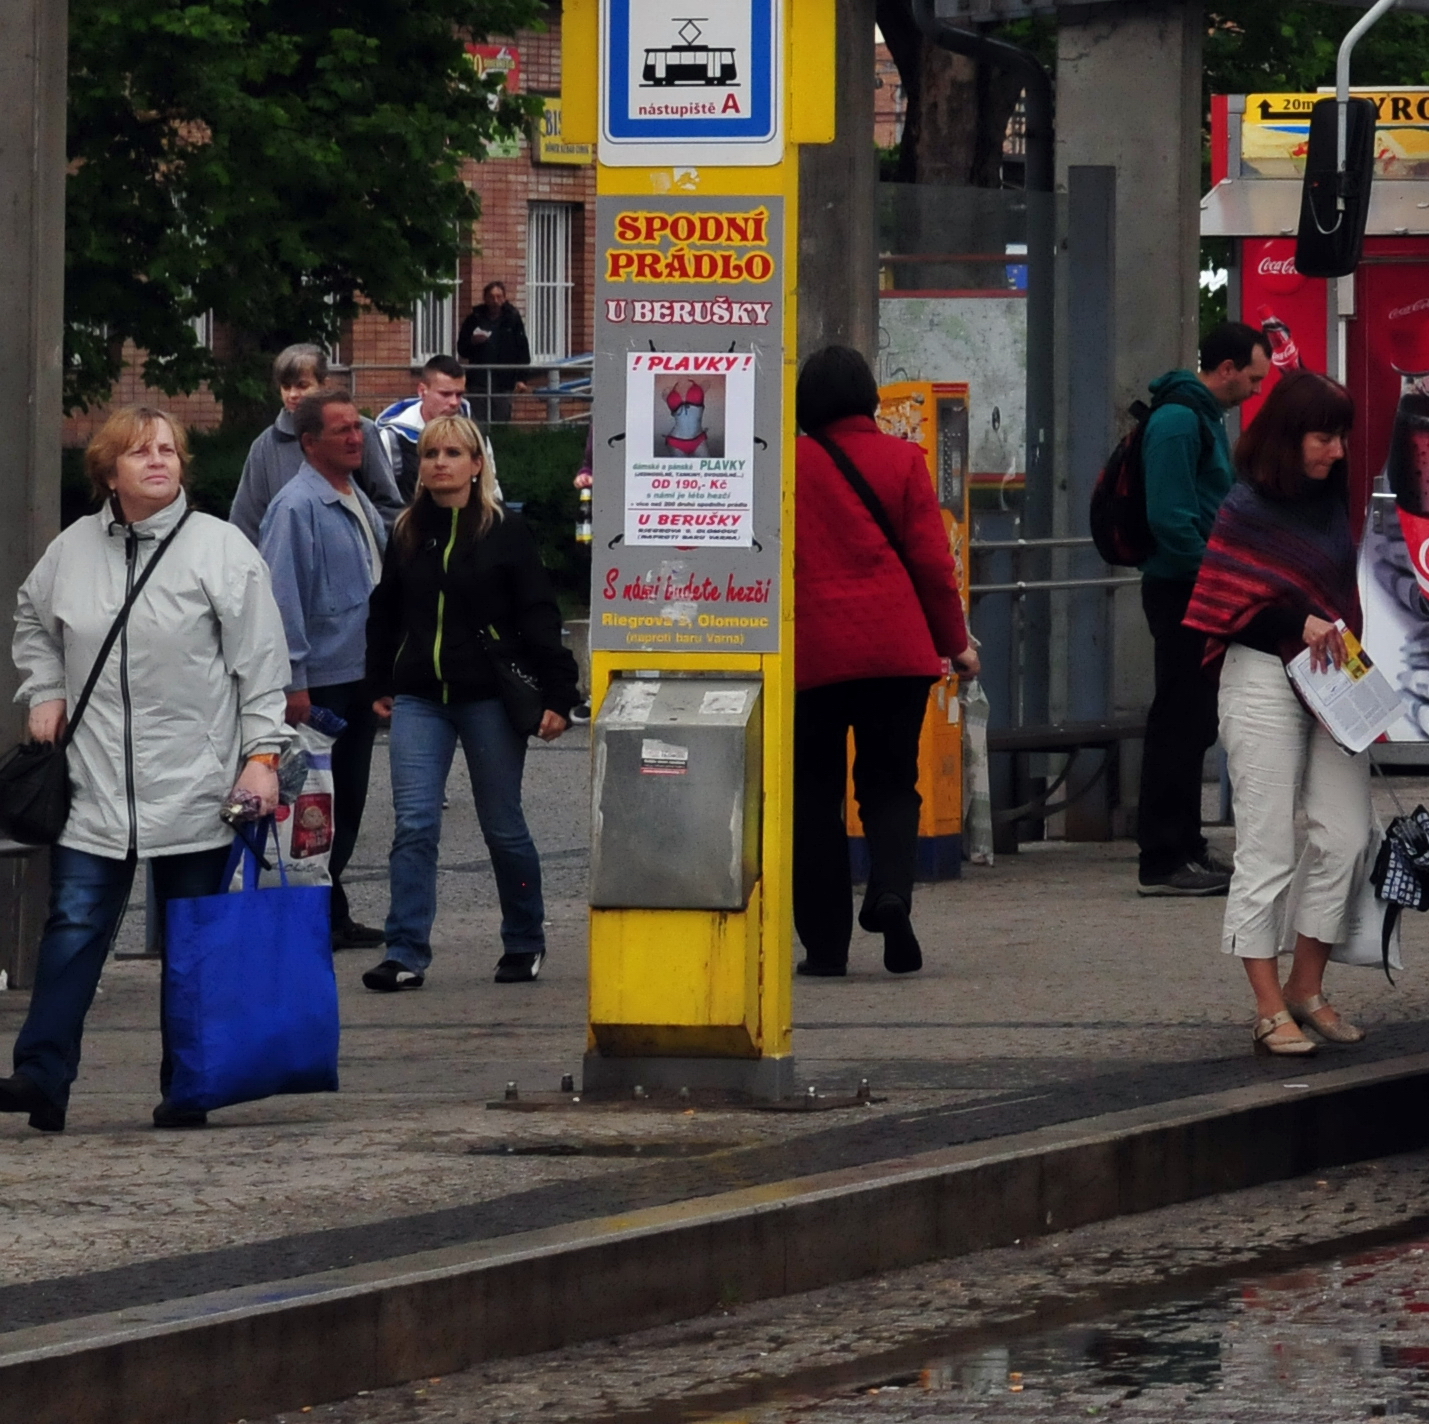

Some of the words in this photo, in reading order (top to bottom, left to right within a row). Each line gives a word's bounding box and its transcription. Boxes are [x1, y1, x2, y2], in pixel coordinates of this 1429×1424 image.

[638, 101, 716, 118] nástupiště
[720, 92, 741, 114] A
[616, 208, 768, 245] SPODNÍ
[606, 248, 773, 282] PRÁDLO
[606, 300, 628, 324] U
[632, 296, 772, 326] BERUŠKY
[647, 355, 739, 372] PLAVKY
[699, 459, 746, 471] PLAVKY
[651, 478, 671, 490] OD
[675, 478, 706, 491] 190,-
[709, 478, 728, 490] Kč
[638, 514, 651, 526] U
[657, 511, 743, 526] BERUŠKY
[602, 568, 620, 600] S
[726, 573, 772, 603] hezčí
[602, 612, 673, 629] Riegrova
[697, 613, 769, 628] Olomouc
